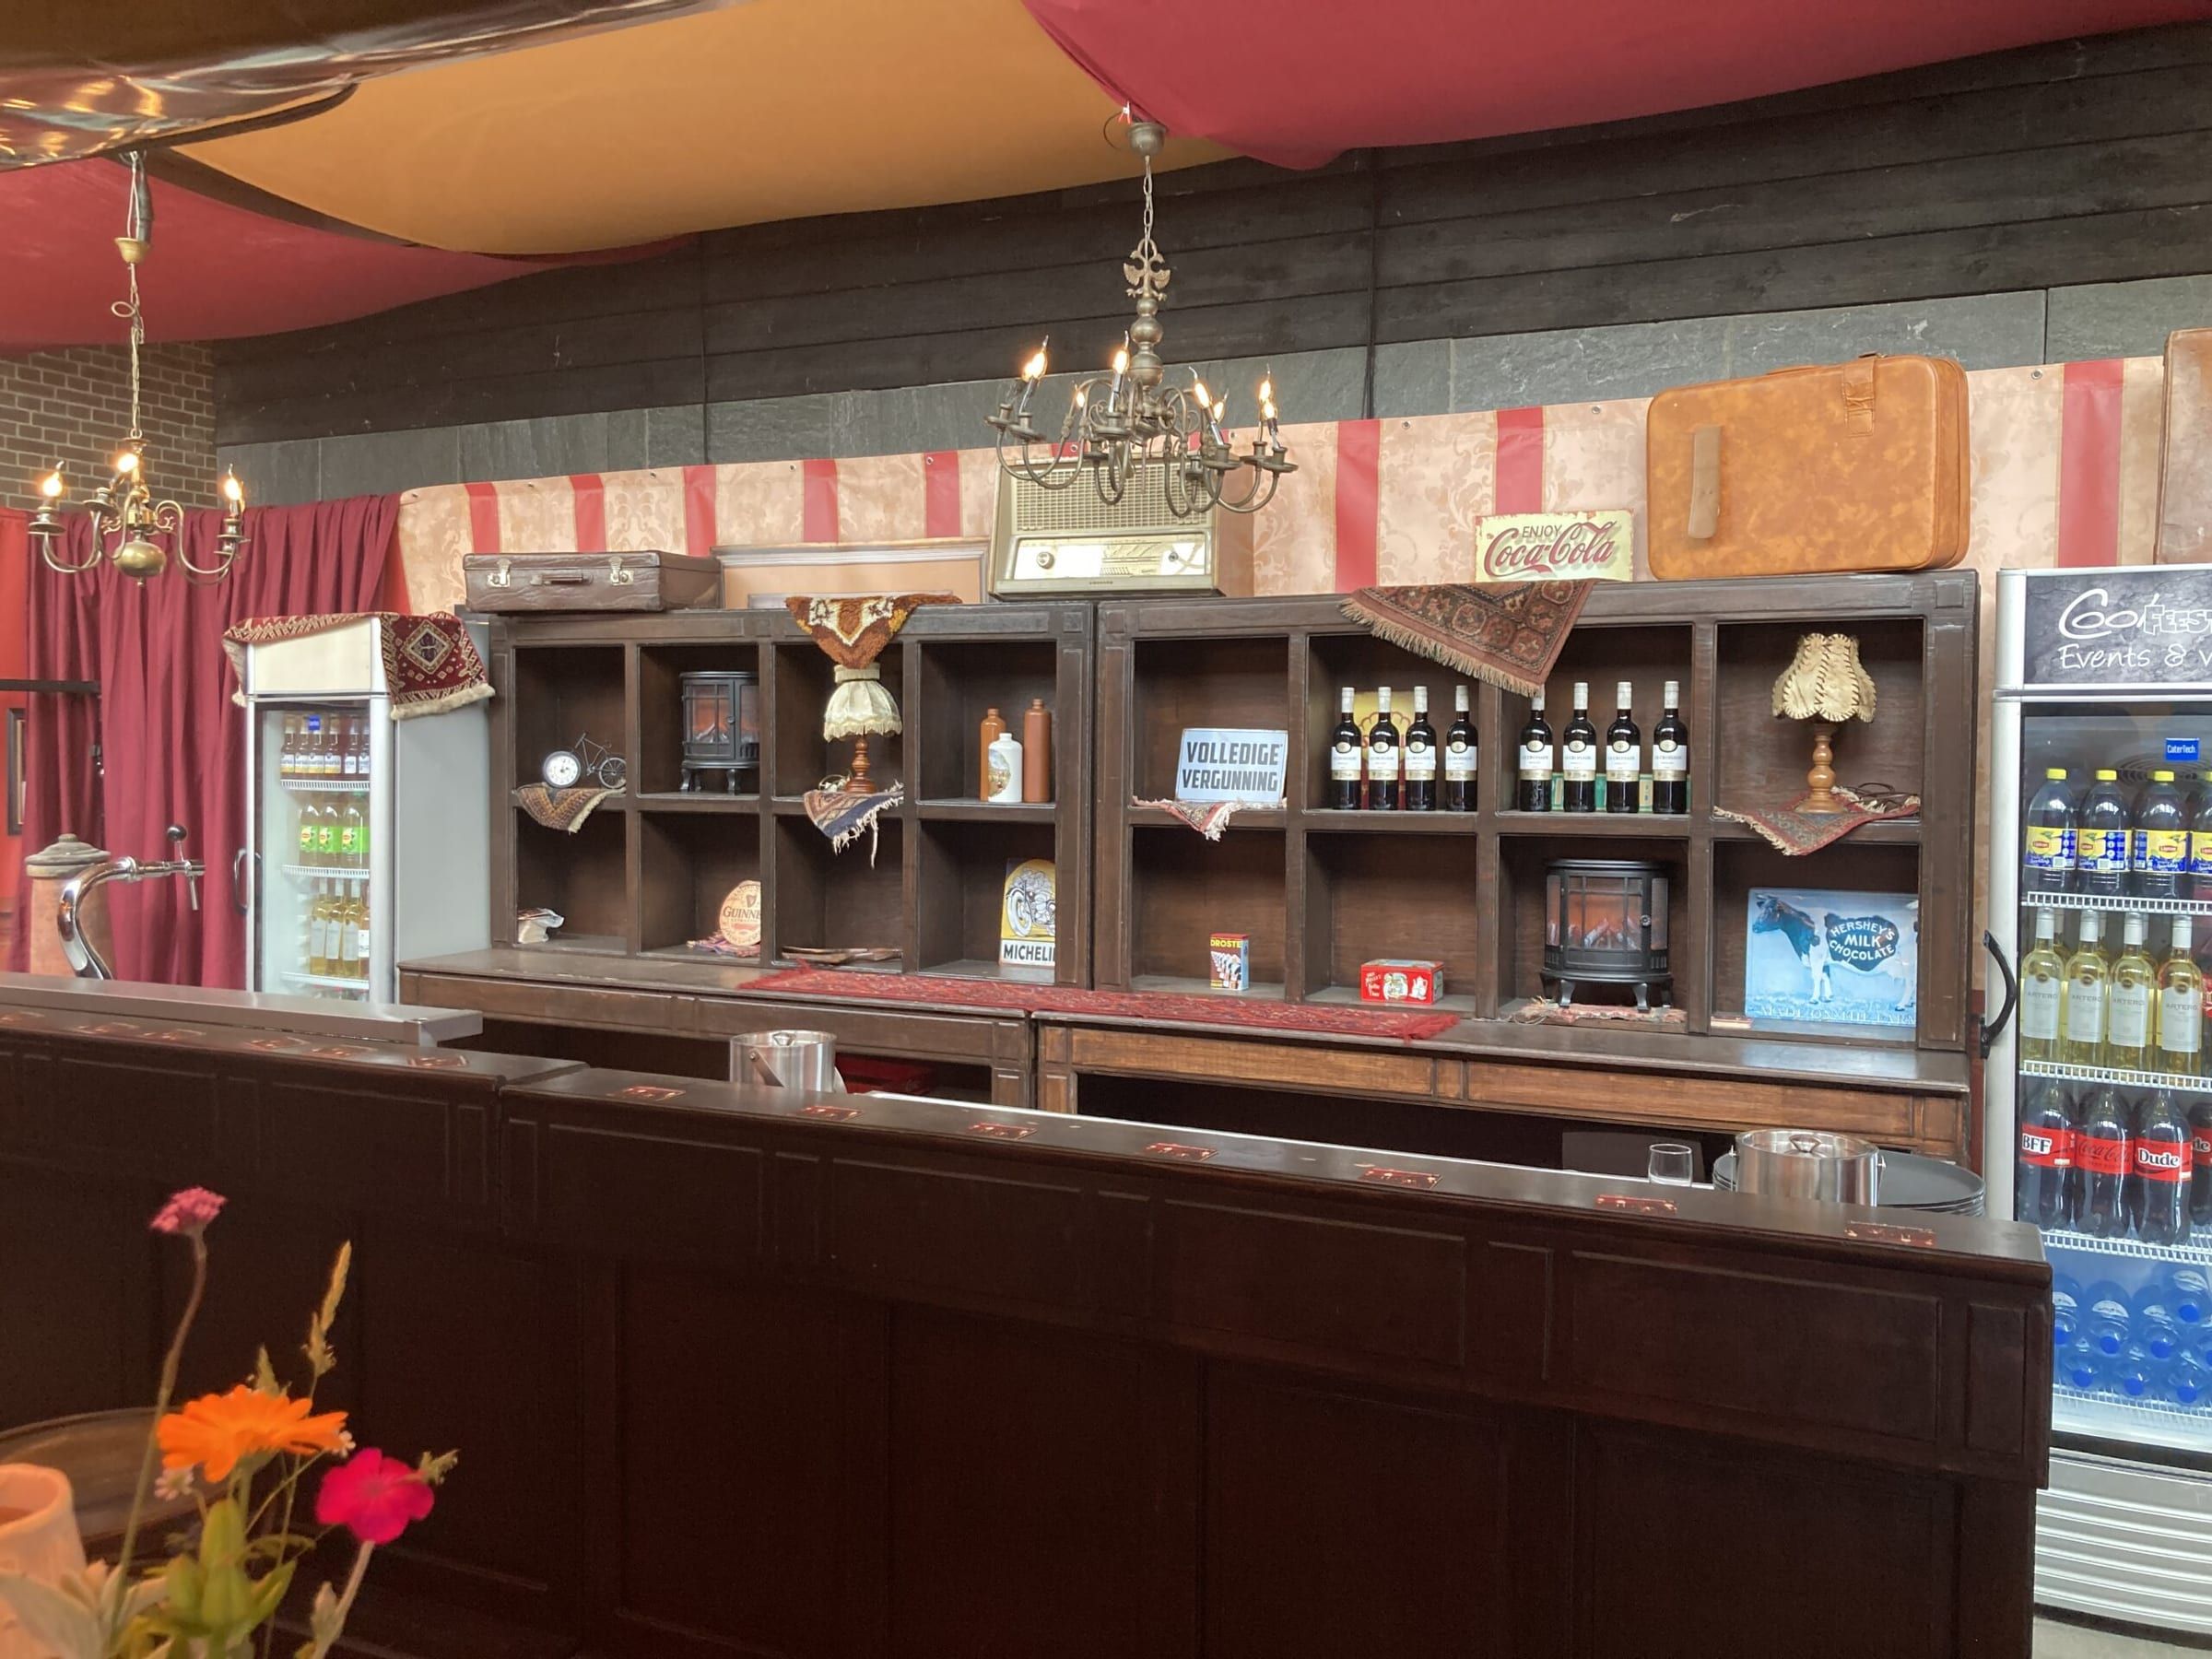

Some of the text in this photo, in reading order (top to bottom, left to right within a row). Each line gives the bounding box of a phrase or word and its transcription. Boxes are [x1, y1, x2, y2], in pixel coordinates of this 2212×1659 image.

[1522, 524, 1562, 538] ENJOY
[1484, 521, 1618, 577] Coca-Cola
[2058, 643, 2151, 669] Events
[2165, 643, 2187, 667] &
[1187, 742, 1280, 765] VOLLEDIGE
[1182, 769, 1278, 792] VERGUNNING
[1830, 921, 1895, 941] HERSHEY'S
[1844, 934, 1882, 947] MILK
[1003, 943, 1055, 961] MICHELI
[1210, 939, 1242, 948] DROSTE
[1829, 939, 1895, 960] CHOCOLATE
[2022, 1136, 2051, 1153] BFF
[2139, 1148, 2179, 1167] Dude
